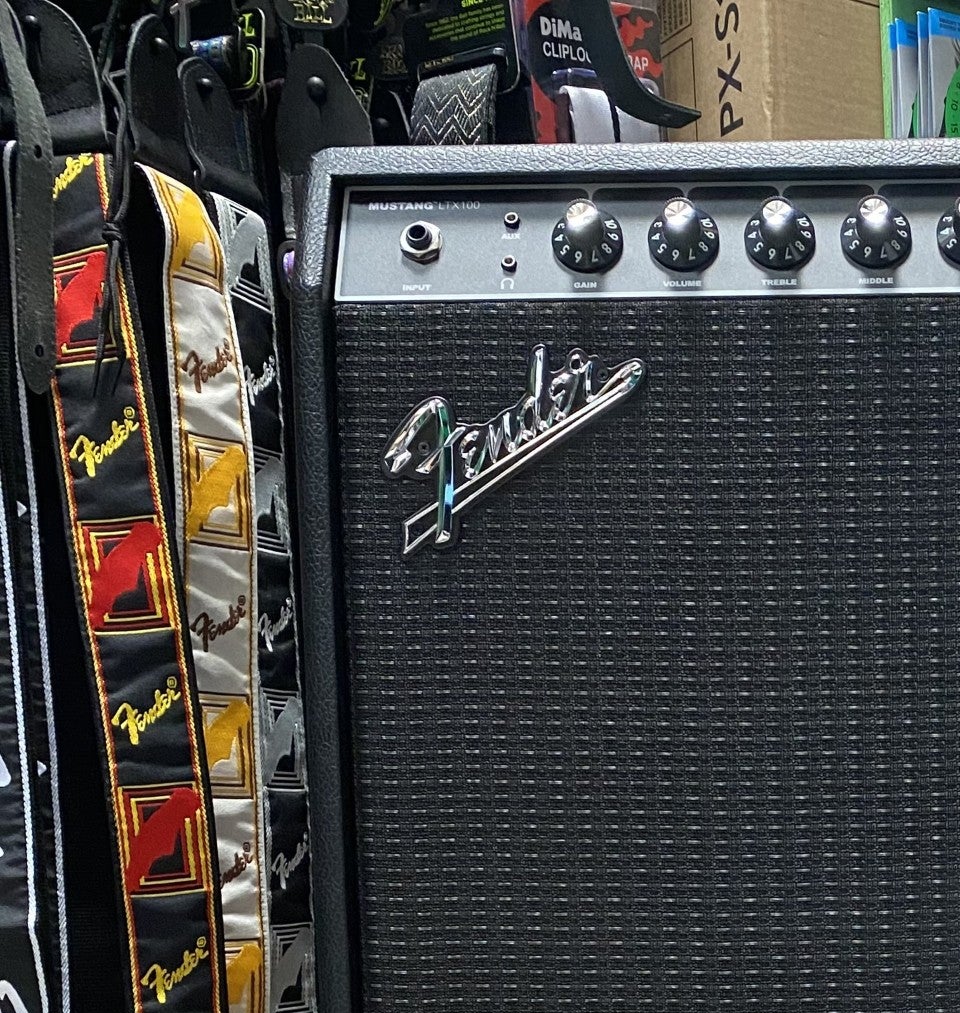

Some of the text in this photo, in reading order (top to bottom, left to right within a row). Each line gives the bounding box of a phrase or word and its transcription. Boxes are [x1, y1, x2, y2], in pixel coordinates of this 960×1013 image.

[540, 16, 582, 42] DiMa
[368, 202, 434, 211] MUSTANG
[501, 233, 521, 241] AUX
[573, 281, 598, 290] GAIN
[662, 279, 703, 288] VOLUME
[761, 278, 798, 287] TREBLE
[859, 277, 895, 286] MIDDLE
[402, 284, 432, 292] INPUT
[383, 344, 645, 552] Fender
